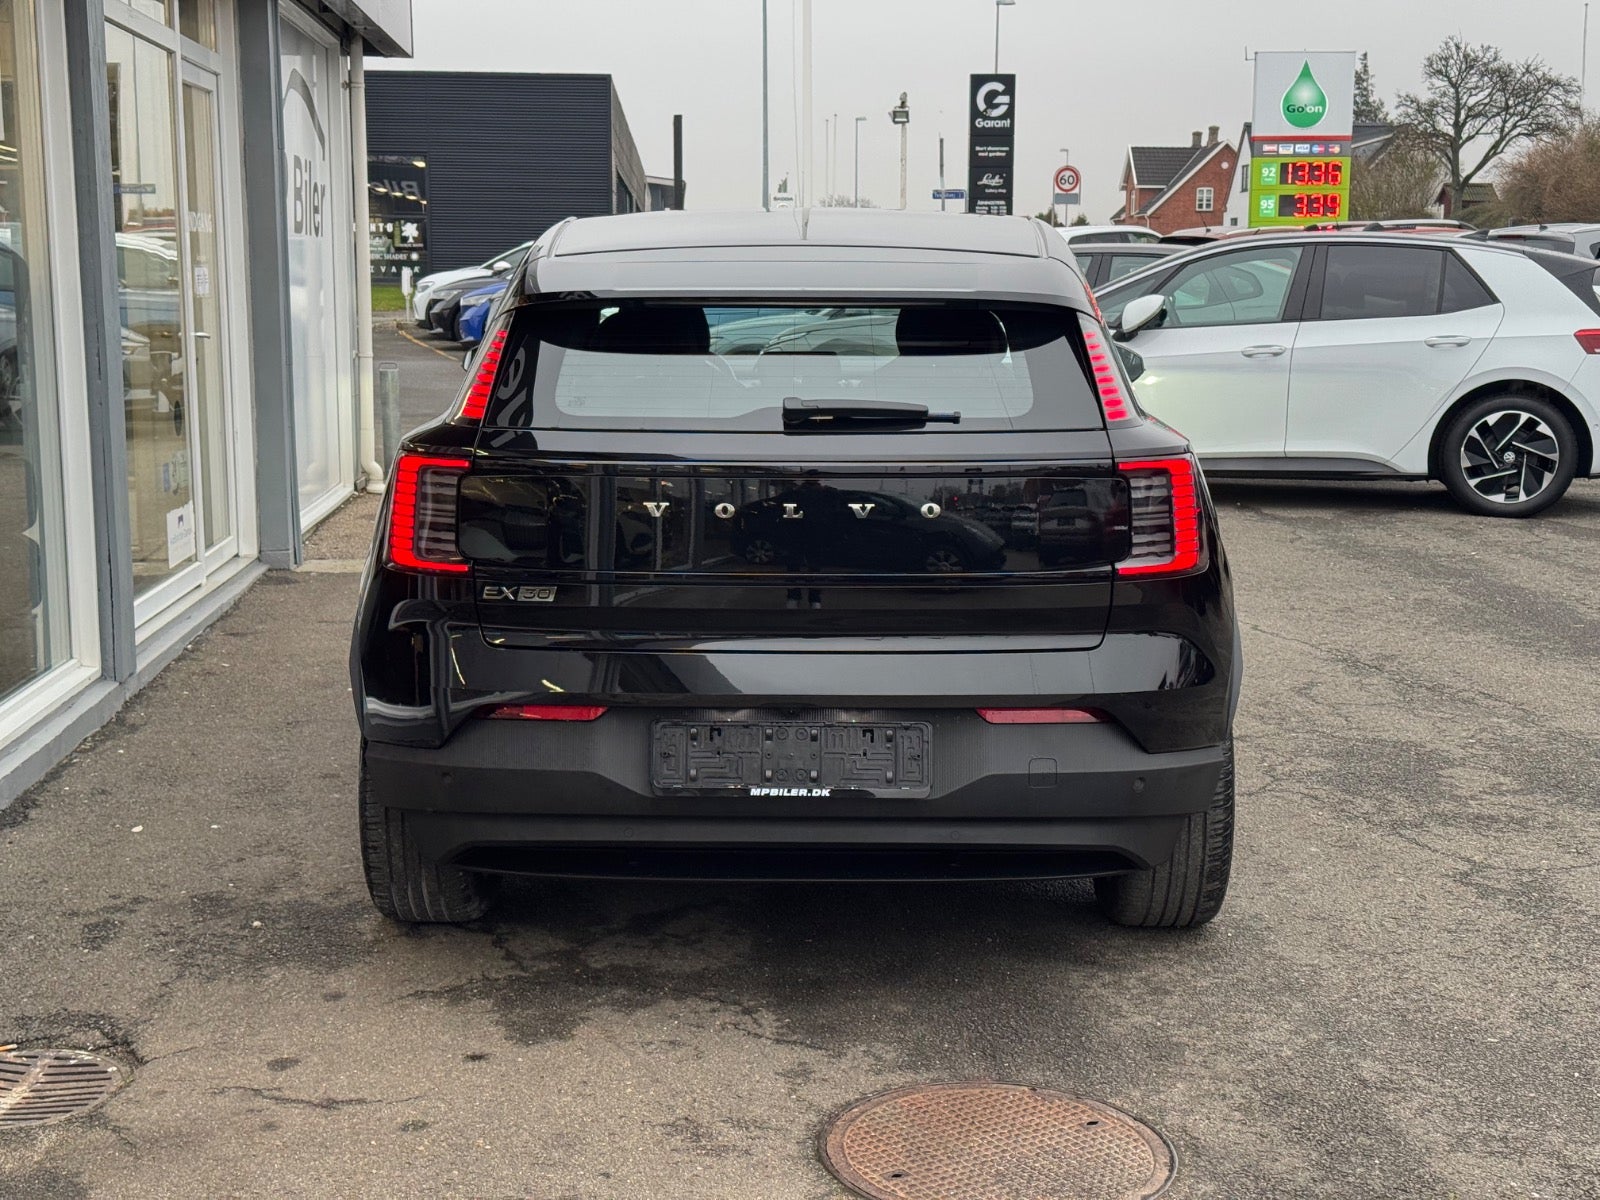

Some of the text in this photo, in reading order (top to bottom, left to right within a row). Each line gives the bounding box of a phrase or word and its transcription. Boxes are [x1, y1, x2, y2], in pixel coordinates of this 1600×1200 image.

[1287, 104, 1322, 113] Go'on
[975, 118, 1011, 128] Garant
[1262, 167, 1276, 177] 92
[1288, 161, 1342, 185] 13.36
[1059, 174, 1075, 185] 60
[293, 154, 326, 238] Biler
[1260, 199, 1275, 209] 95
[1294, 194, 1340, 216] 3.39
[644, 502, 941, 519] VOLVO
[482, 586, 556, 602] EX30
[750, 788, 831, 797] MPBILER.DK
